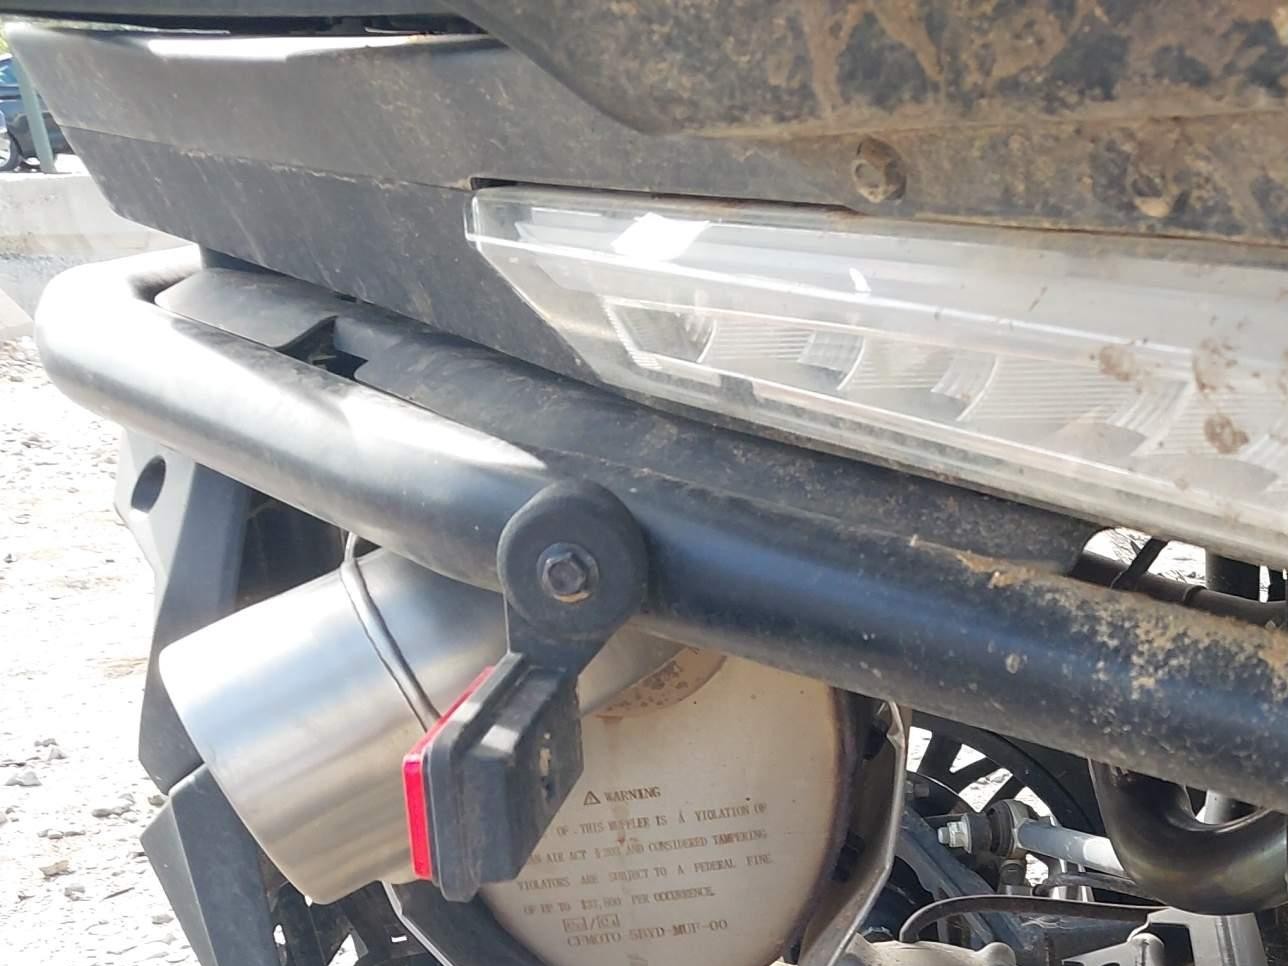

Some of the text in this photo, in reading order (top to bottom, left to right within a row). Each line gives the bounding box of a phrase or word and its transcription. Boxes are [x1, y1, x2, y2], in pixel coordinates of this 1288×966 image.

[604, 786, 661, 802] WARNING
[579, 822, 604, 835] THIS
[655, 815, 668, 827] IS
[678, 808, 686, 824] A
[694, 804, 750, 823] VIOLATION
[569, 849, 588, 861] ACT
[648, 837, 709, 854] CONSIDERED
[711, 828, 768, 846] TAMPERING
[517, 876, 571, 891] VIOLATORS
[608, 868, 649, 883] SUBJECT
[653, 866, 668, 878] TO
[677, 864, 686, 876] A
[694, 857, 737, 873] FEDERAL
[745, 852, 772, 867] FINE
[558, 901, 571, 913] TO
[631, 893, 650, 905] PER
[567, 931, 622, 947] CFMOTO
